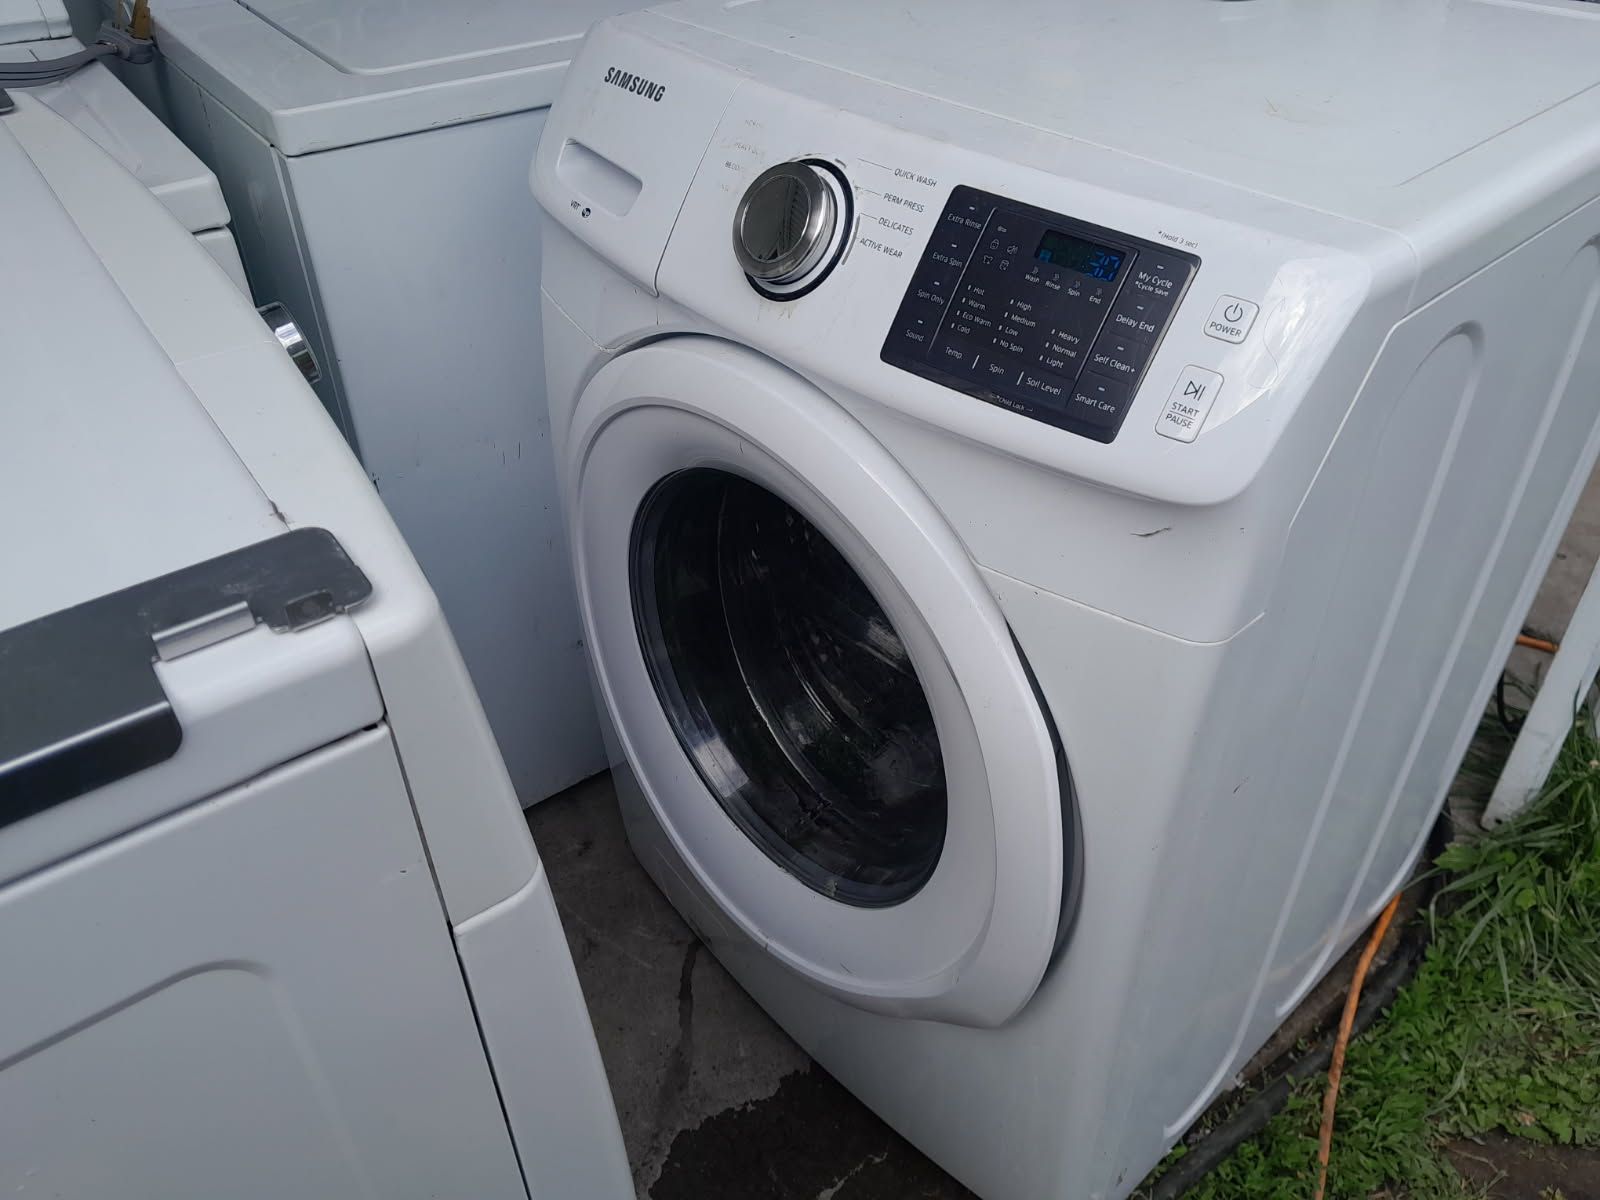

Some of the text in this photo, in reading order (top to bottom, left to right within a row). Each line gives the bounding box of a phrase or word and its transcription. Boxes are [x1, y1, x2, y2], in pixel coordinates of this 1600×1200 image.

[604, 66, 666, 103] SAMSUNG
[894, 168, 937, 187] QUICK WASH
[883, 192, 924, 213] PERM PRESS
[878, 217, 913, 235] DELICATES
[948, 213, 982, 229] Extra Rinse
[860, 237, 903, 259] ACTIVE WEAR
[1184, 239, 1199, 249] sec)
[933, 252, 962, 268] Extra Spin
[1025, 274, 1039, 283] Wash
[1045, 281, 1060, 290] Rinse
[1139, 272, 1173, 288] My Cycle
[917, 289, 945, 305] Spin Only
[974, 286, 985, 295] Hot
[1068, 288, 1080, 297] Spin
[1154, 286, 1169, 296] Save
[969, 299, 986, 310] Warm
[1017, 300, 1032, 312] High
[1089, 295, 1101, 304] End
[962, 311, 992, 327] Eco Warm
[1011, 314, 1036, 328] Medium
[1116, 314, 1155, 333] Delay End
[906, 329, 924, 342] Sound
[957, 324, 970, 334] Cold
[1005, 326, 1018, 337] Low
[1210, 321, 1242, 337] POWER
[1059, 330, 1080, 344] Heavy
[1000, 339, 1024, 353] No Spin
[1052, 344, 1077, 358] Normal
[1046, 357, 1064, 369] Light
[1094, 354, 1111, 366] Self
[989, 363, 1004, 375] Spin
[1027, 377, 1062, 396] Soil Level
[1011, 400, 1024, 411] Lock
[1075, 393, 1115, 413] Smart Care
[1171, 401, 1200, 417] START
[1165, 413, 1193, 429] PAUSE
